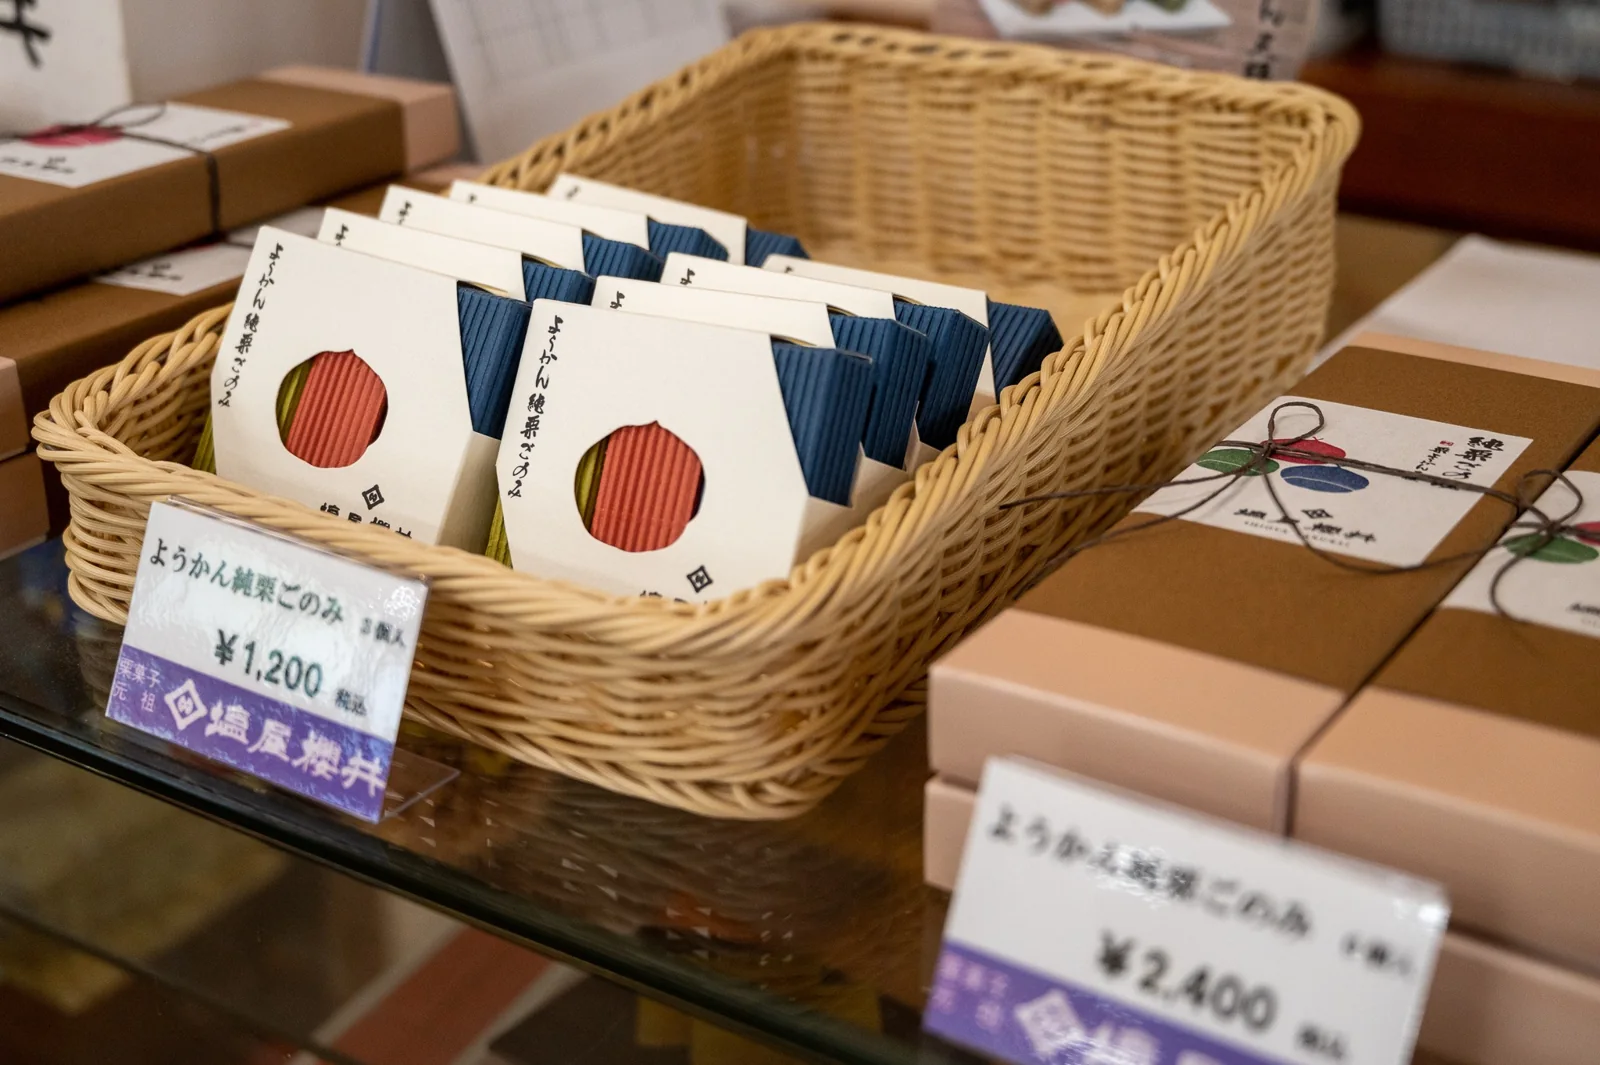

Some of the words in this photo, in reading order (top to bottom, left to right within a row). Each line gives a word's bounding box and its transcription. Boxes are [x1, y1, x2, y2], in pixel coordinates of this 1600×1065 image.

[150, 538, 344, 625] ようかん純栗ごのみ
[214, 629, 322, 699] ¥1,200
